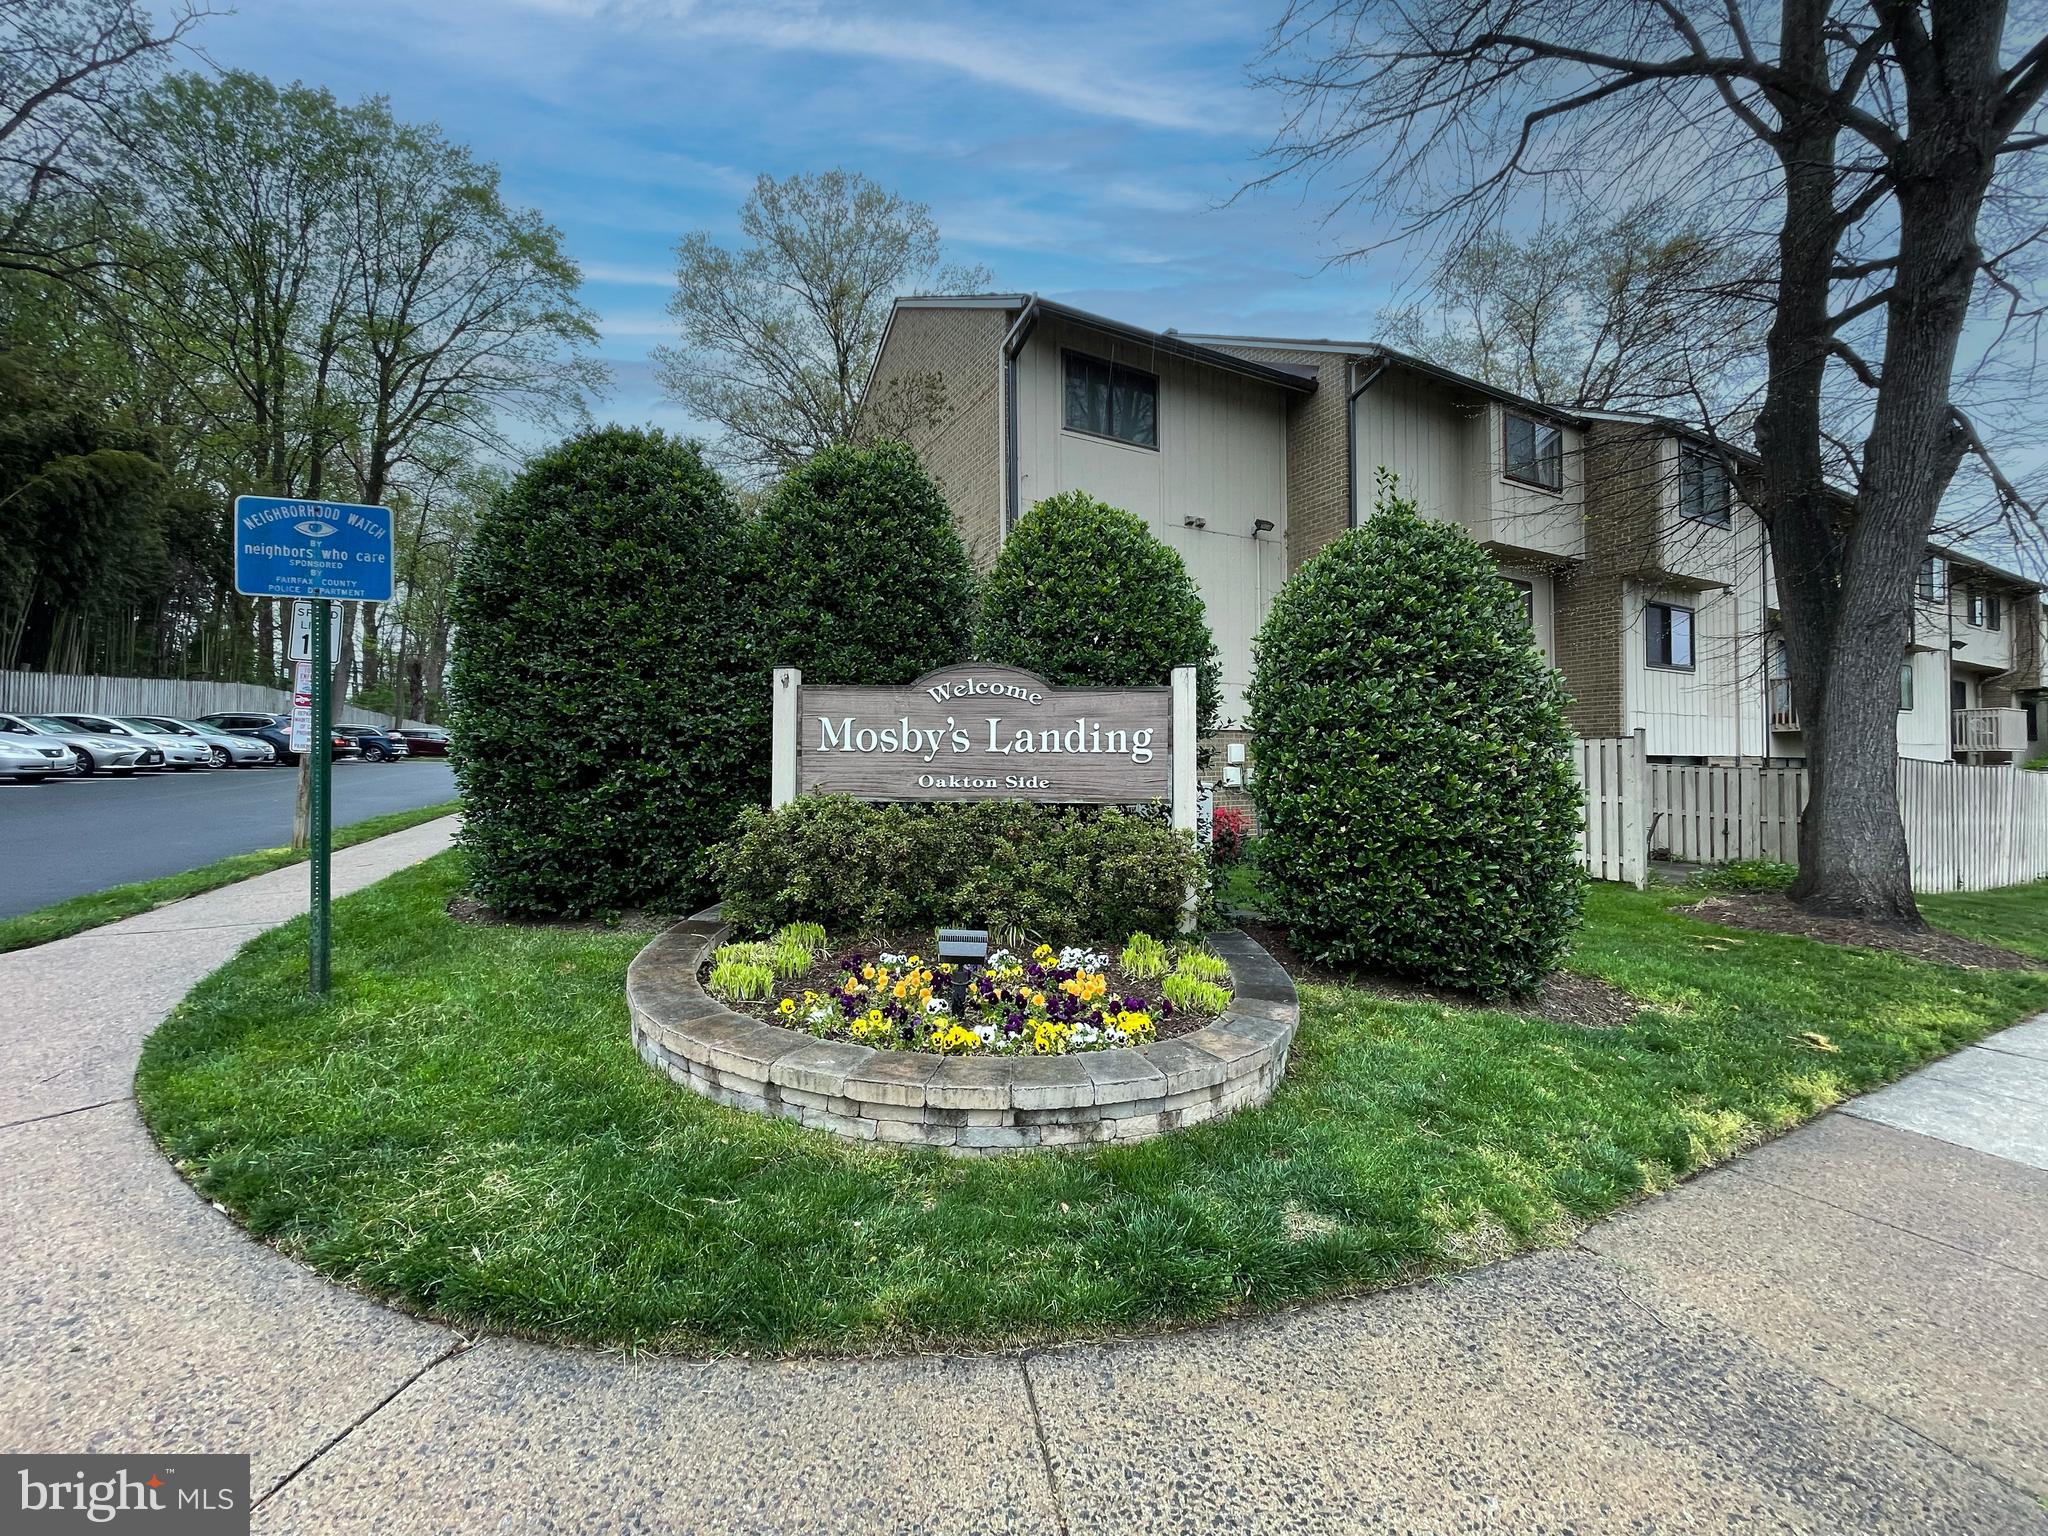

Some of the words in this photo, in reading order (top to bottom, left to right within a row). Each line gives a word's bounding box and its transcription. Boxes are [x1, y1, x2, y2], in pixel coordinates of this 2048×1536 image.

[242, 505, 340, 530] NEIGHBORHOOD
[347, 512, 386, 540] WATCH
[244, 543, 314, 560] neighbors
[321, 549, 348, 561] who
[355, 551, 386, 563] care
[289, 559, 343, 569] SPONSORED
[310, 569, 323, 577] BY
[275, 576, 314, 585] FAIRFAX
[321, 579, 357, 588] COUNTY
[268, 584, 301, 593] POLICE
[307, 587, 365, 597] DPARTMENT
[298, 608, 339, 620] SPD
[926, 678, 1044, 705] Welcome
[816, 716, 971, 762] Mosby's
[984, 717, 1154, 764] Landing
[918, 774, 998, 789] Oakton
[1005, 774, 1050, 790] Side
